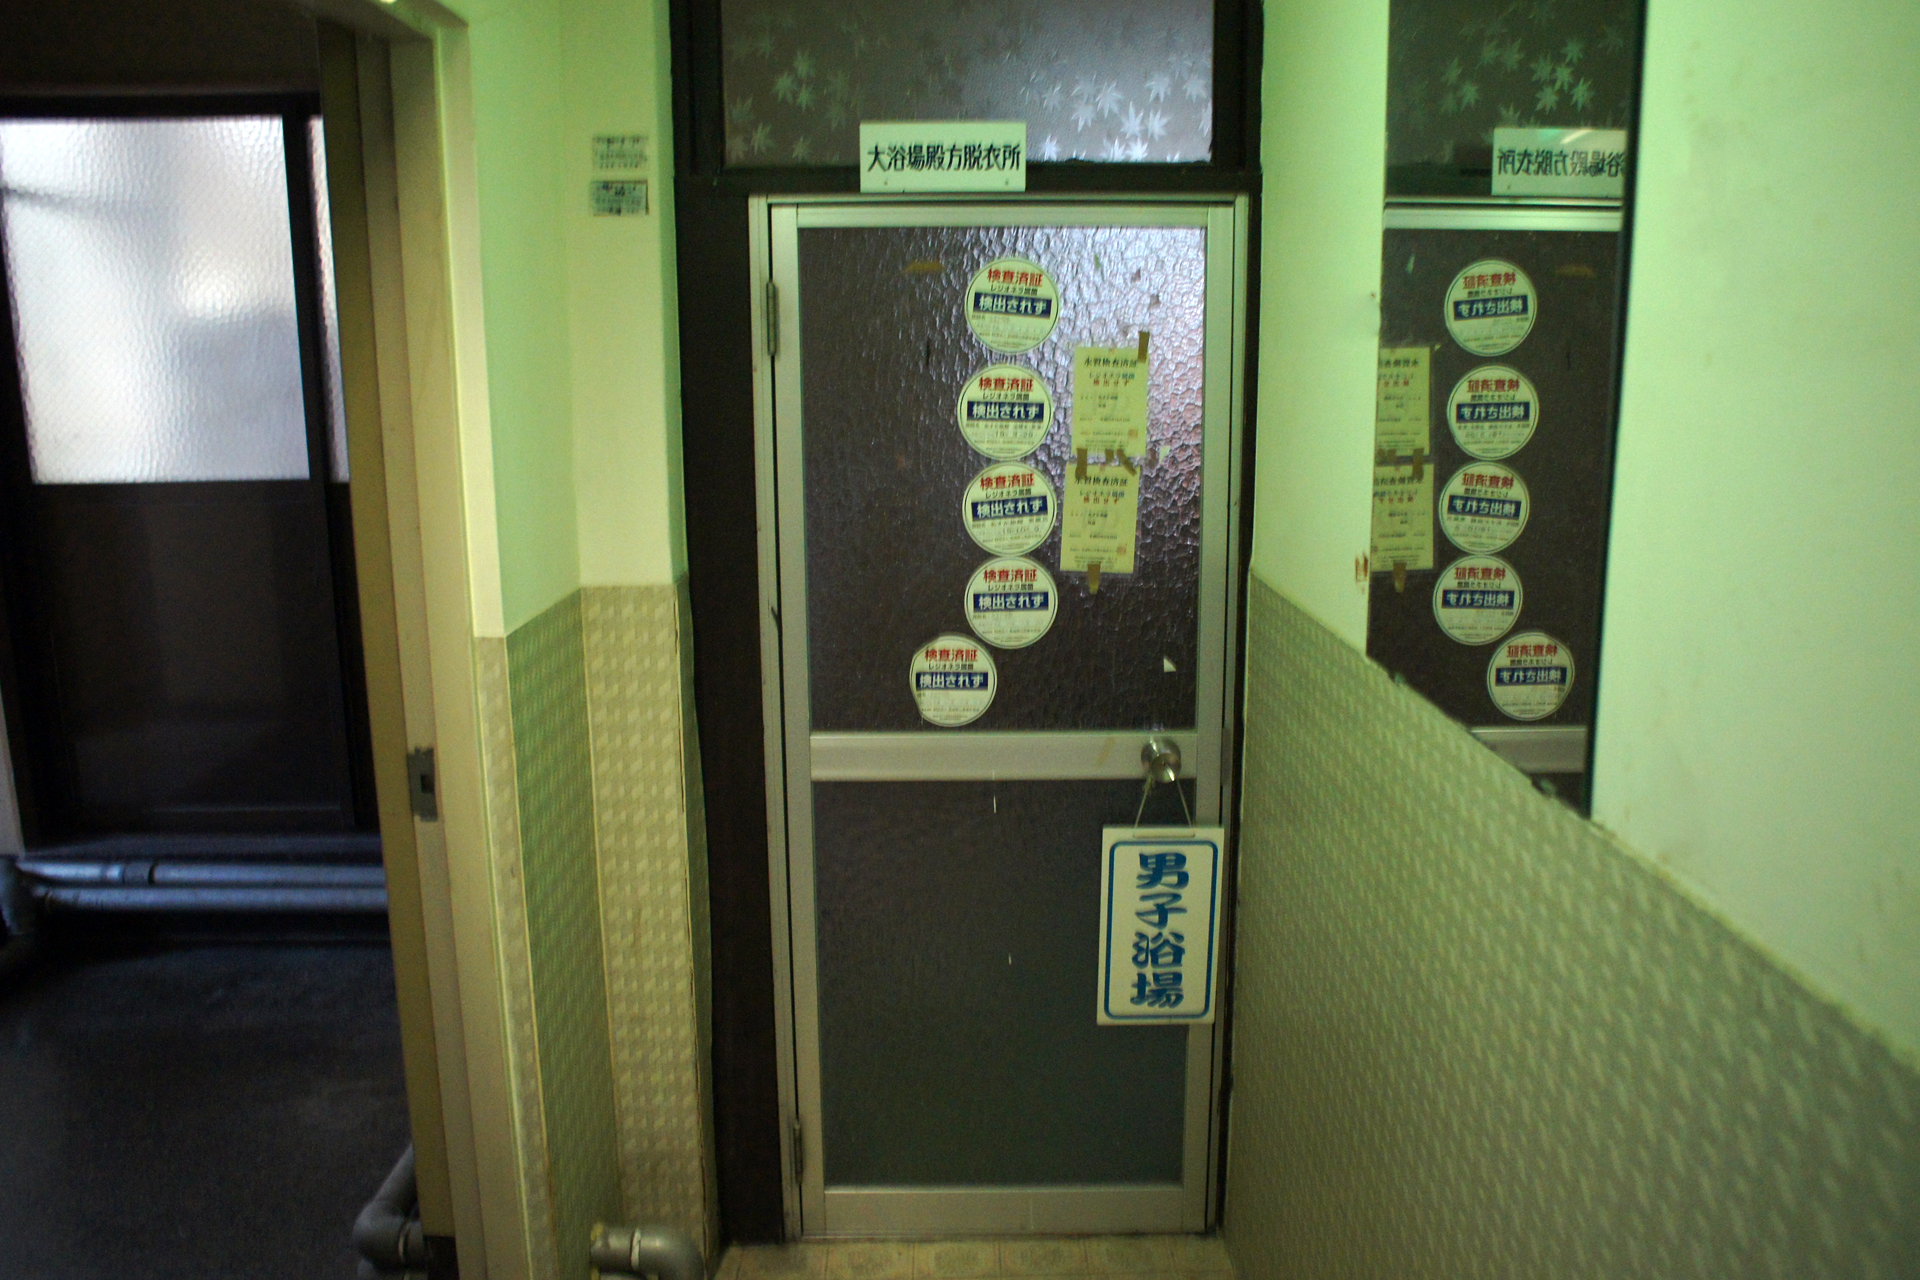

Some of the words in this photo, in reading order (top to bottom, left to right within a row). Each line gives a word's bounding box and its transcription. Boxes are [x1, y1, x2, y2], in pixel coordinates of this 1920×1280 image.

[868, 143, 1021, 172] 大浴場殿方脱衣所
[987, 268, 1042, 287] 検査済証
[979, 294, 1046, 315] 検出されず
[979, 377, 1033, 392] 検査済証
[972, 403, 1039, 419] 検出されず
[980, 474, 1034, 490] 検査済証
[977, 499, 1042, 519] 検出されず
[983, 569, 1037, 584] 検査済証
[979, 595, 1044, 610] 検出されず
[925, 649, 978, 662] 検査済証
[920, 673, 983, 688] 検出されず
[1130, 852, 1189, 1009] 男子浴場
